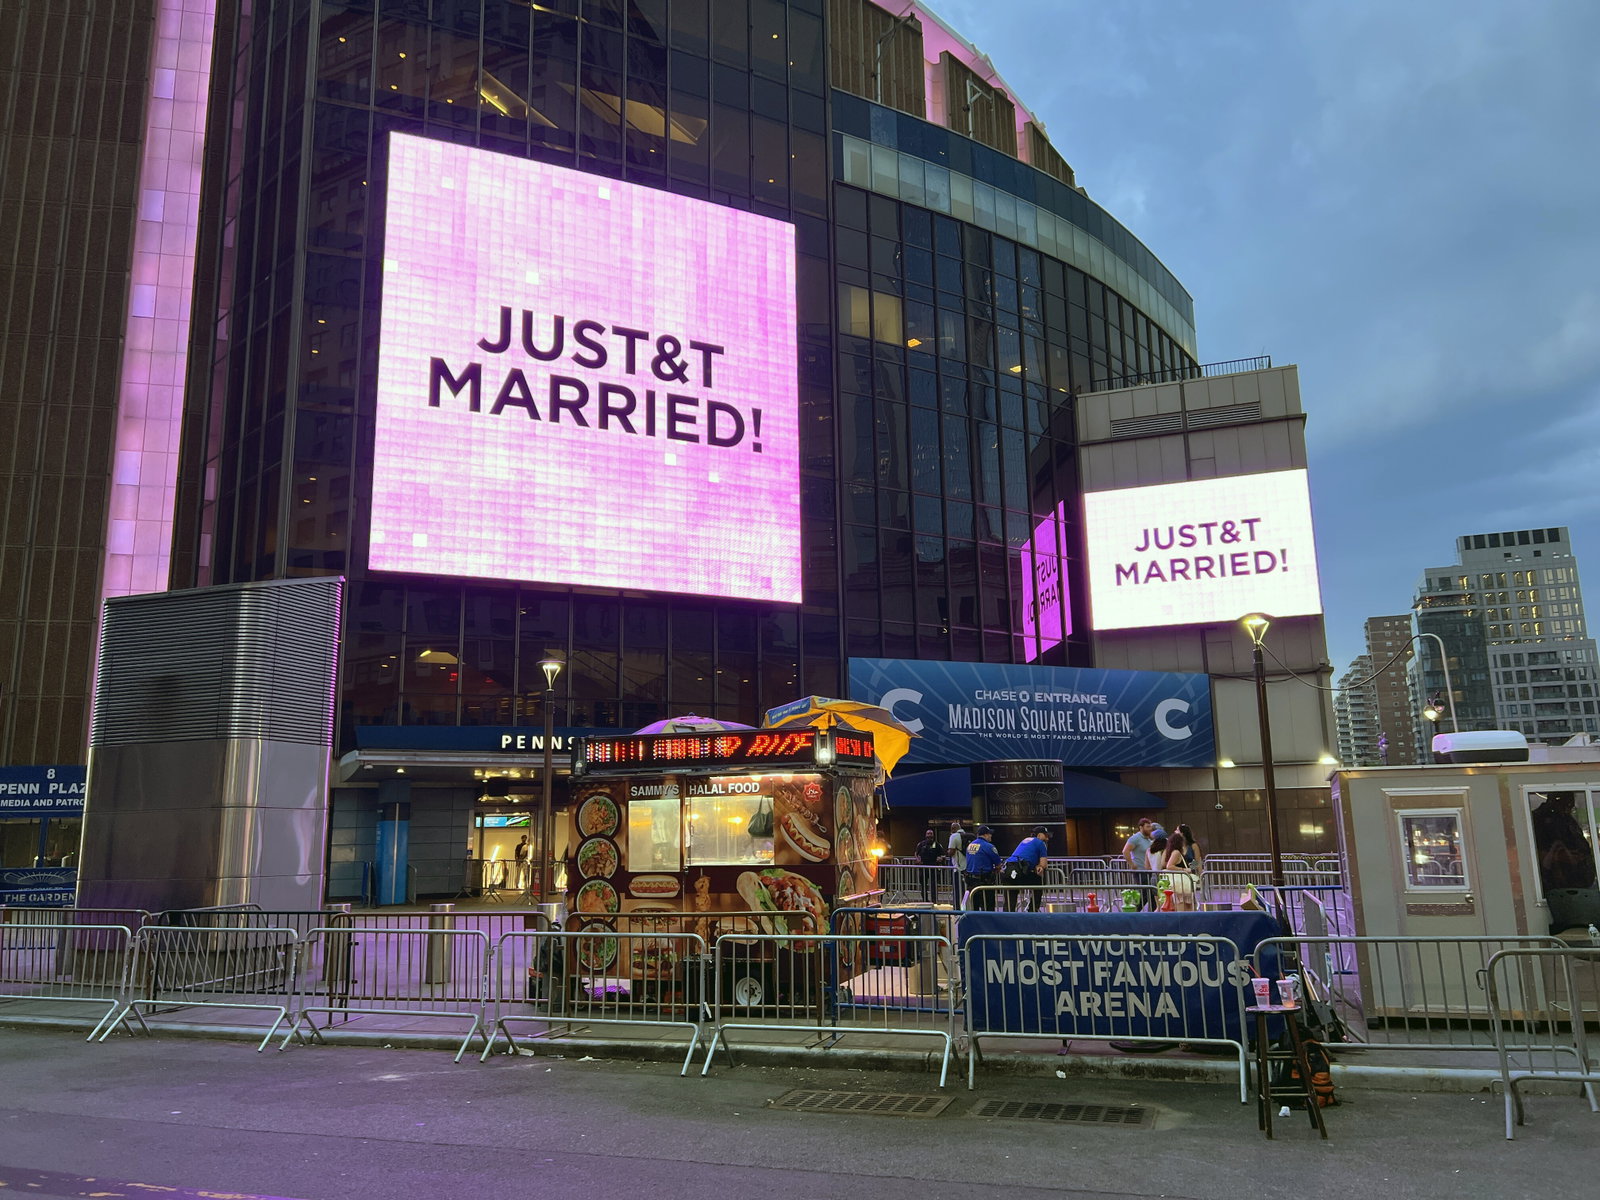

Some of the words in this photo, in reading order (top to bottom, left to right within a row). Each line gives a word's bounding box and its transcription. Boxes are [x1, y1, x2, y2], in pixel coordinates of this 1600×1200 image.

[476, 305, 725, 388] JUST&T
[428, 356, 763, 453] MARRIED!
[1134, 517, 1262, 552] JUST&T
[1115, 548, 1289, 586] MARRIED!
[975, 690, 1017, 701] CHASE
[1034, 692, 1108, 704] ENTRANCE
[949, 703, 1015, 731] MADISON
[1020, 706, 1075, 733] SQUARE
[1155, 698, 1193, 740] C
[46, 768, 56, 780] 8
[1025, 764, 1060, 779] STATION
[0, 783, 40, 795] PENN
[630, 784, 680, 797] SAMMY'S
[689, 783, 726, 795] HALAL
[728, 782, 760, 794] FOOD
[0, 799, 31, 808] MEDIA
[33, 798, 53, 807] AND
[4, 893, 26, 902] THE
[1012, 934, 1069, 956] THE
[1078, 934, 1216, 956] WORLD'S
[986, 959, 1085, 986] MOST
[1093, 959, 1251, 988] FAMOUS
[1056, 990, 1180, 1018] ARENA
